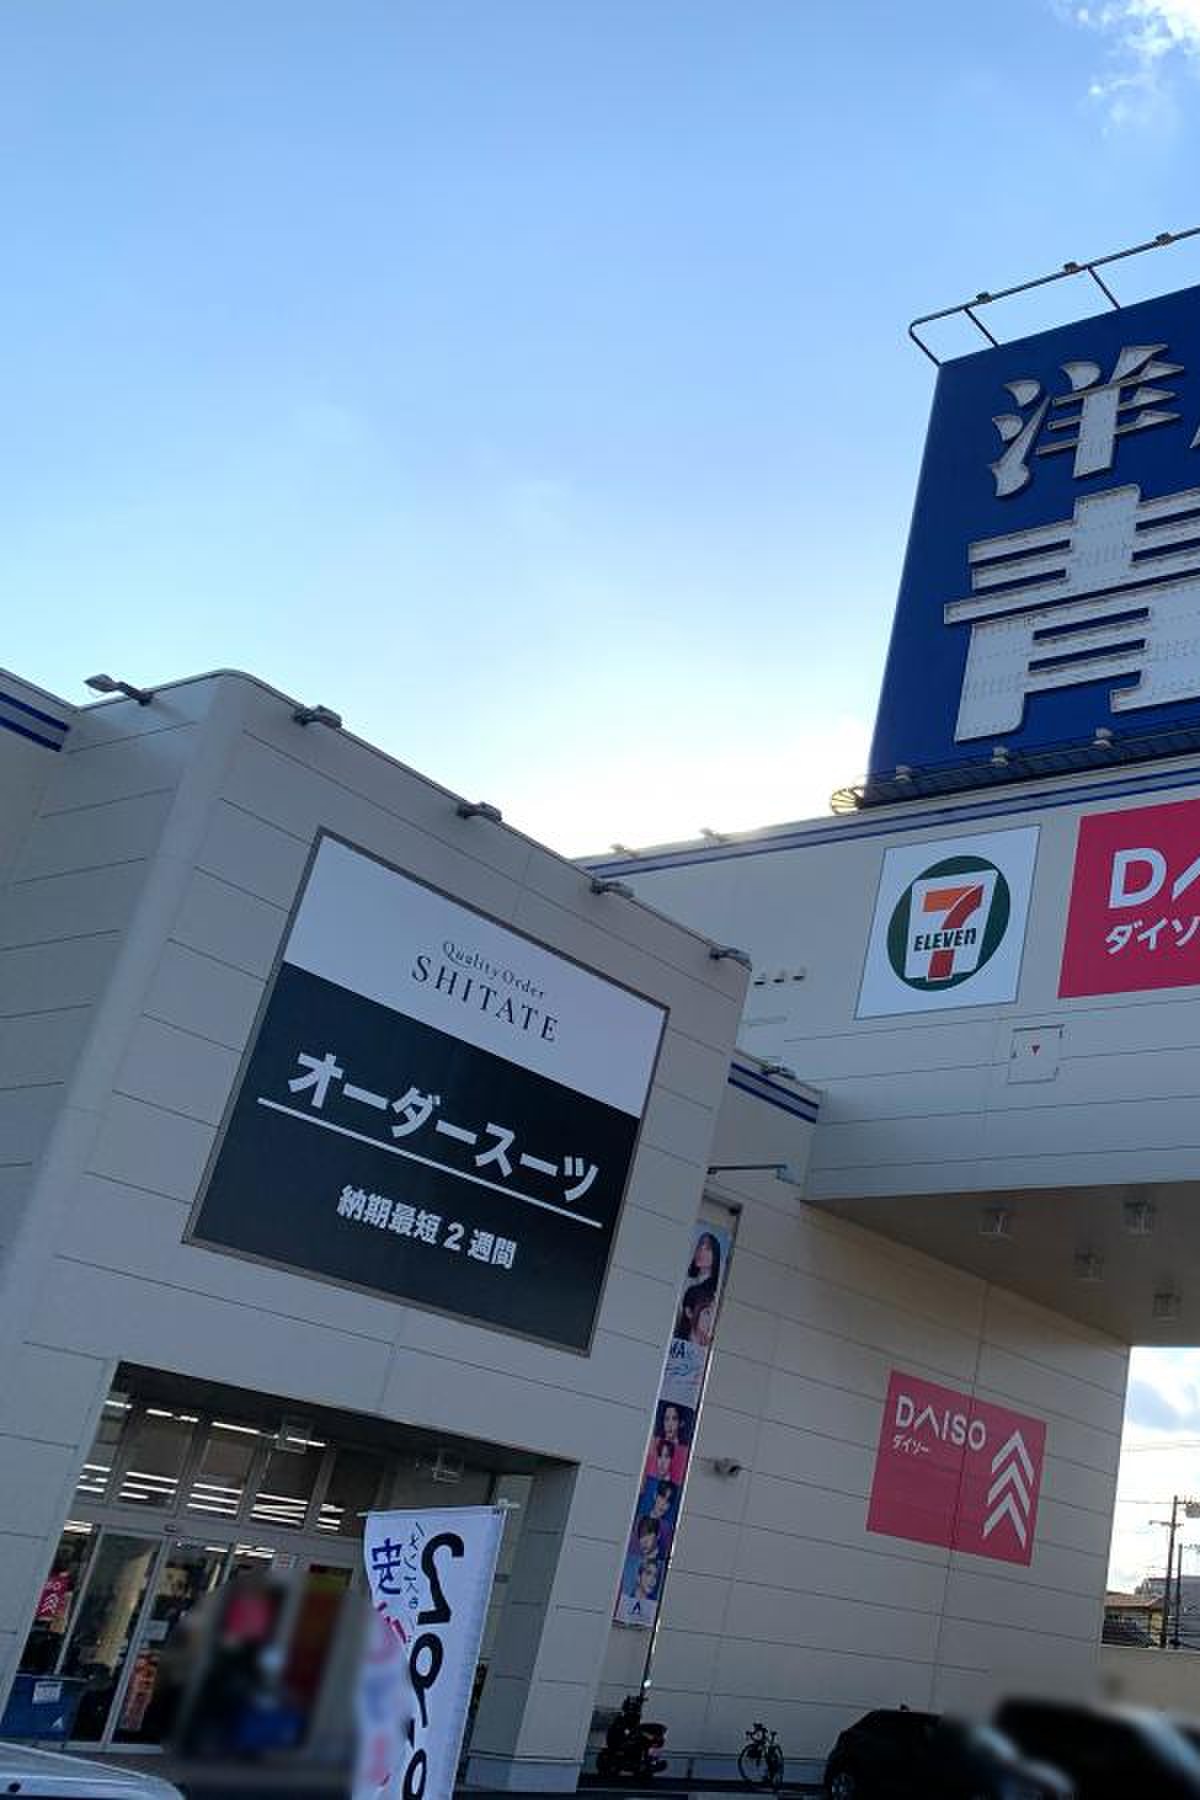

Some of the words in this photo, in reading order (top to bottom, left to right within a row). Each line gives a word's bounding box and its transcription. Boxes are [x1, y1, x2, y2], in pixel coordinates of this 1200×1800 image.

[411, 955, 559, 1042] SHITATE
[443, 941, 498, 980] Quality
[502, 969, 546, 1000] Order
[288, 1052, 599, 1202] オーダースーツ
[893, 1433, 929, 1455] ダイソー
[895, 1395, 986, 1452] DAISO
